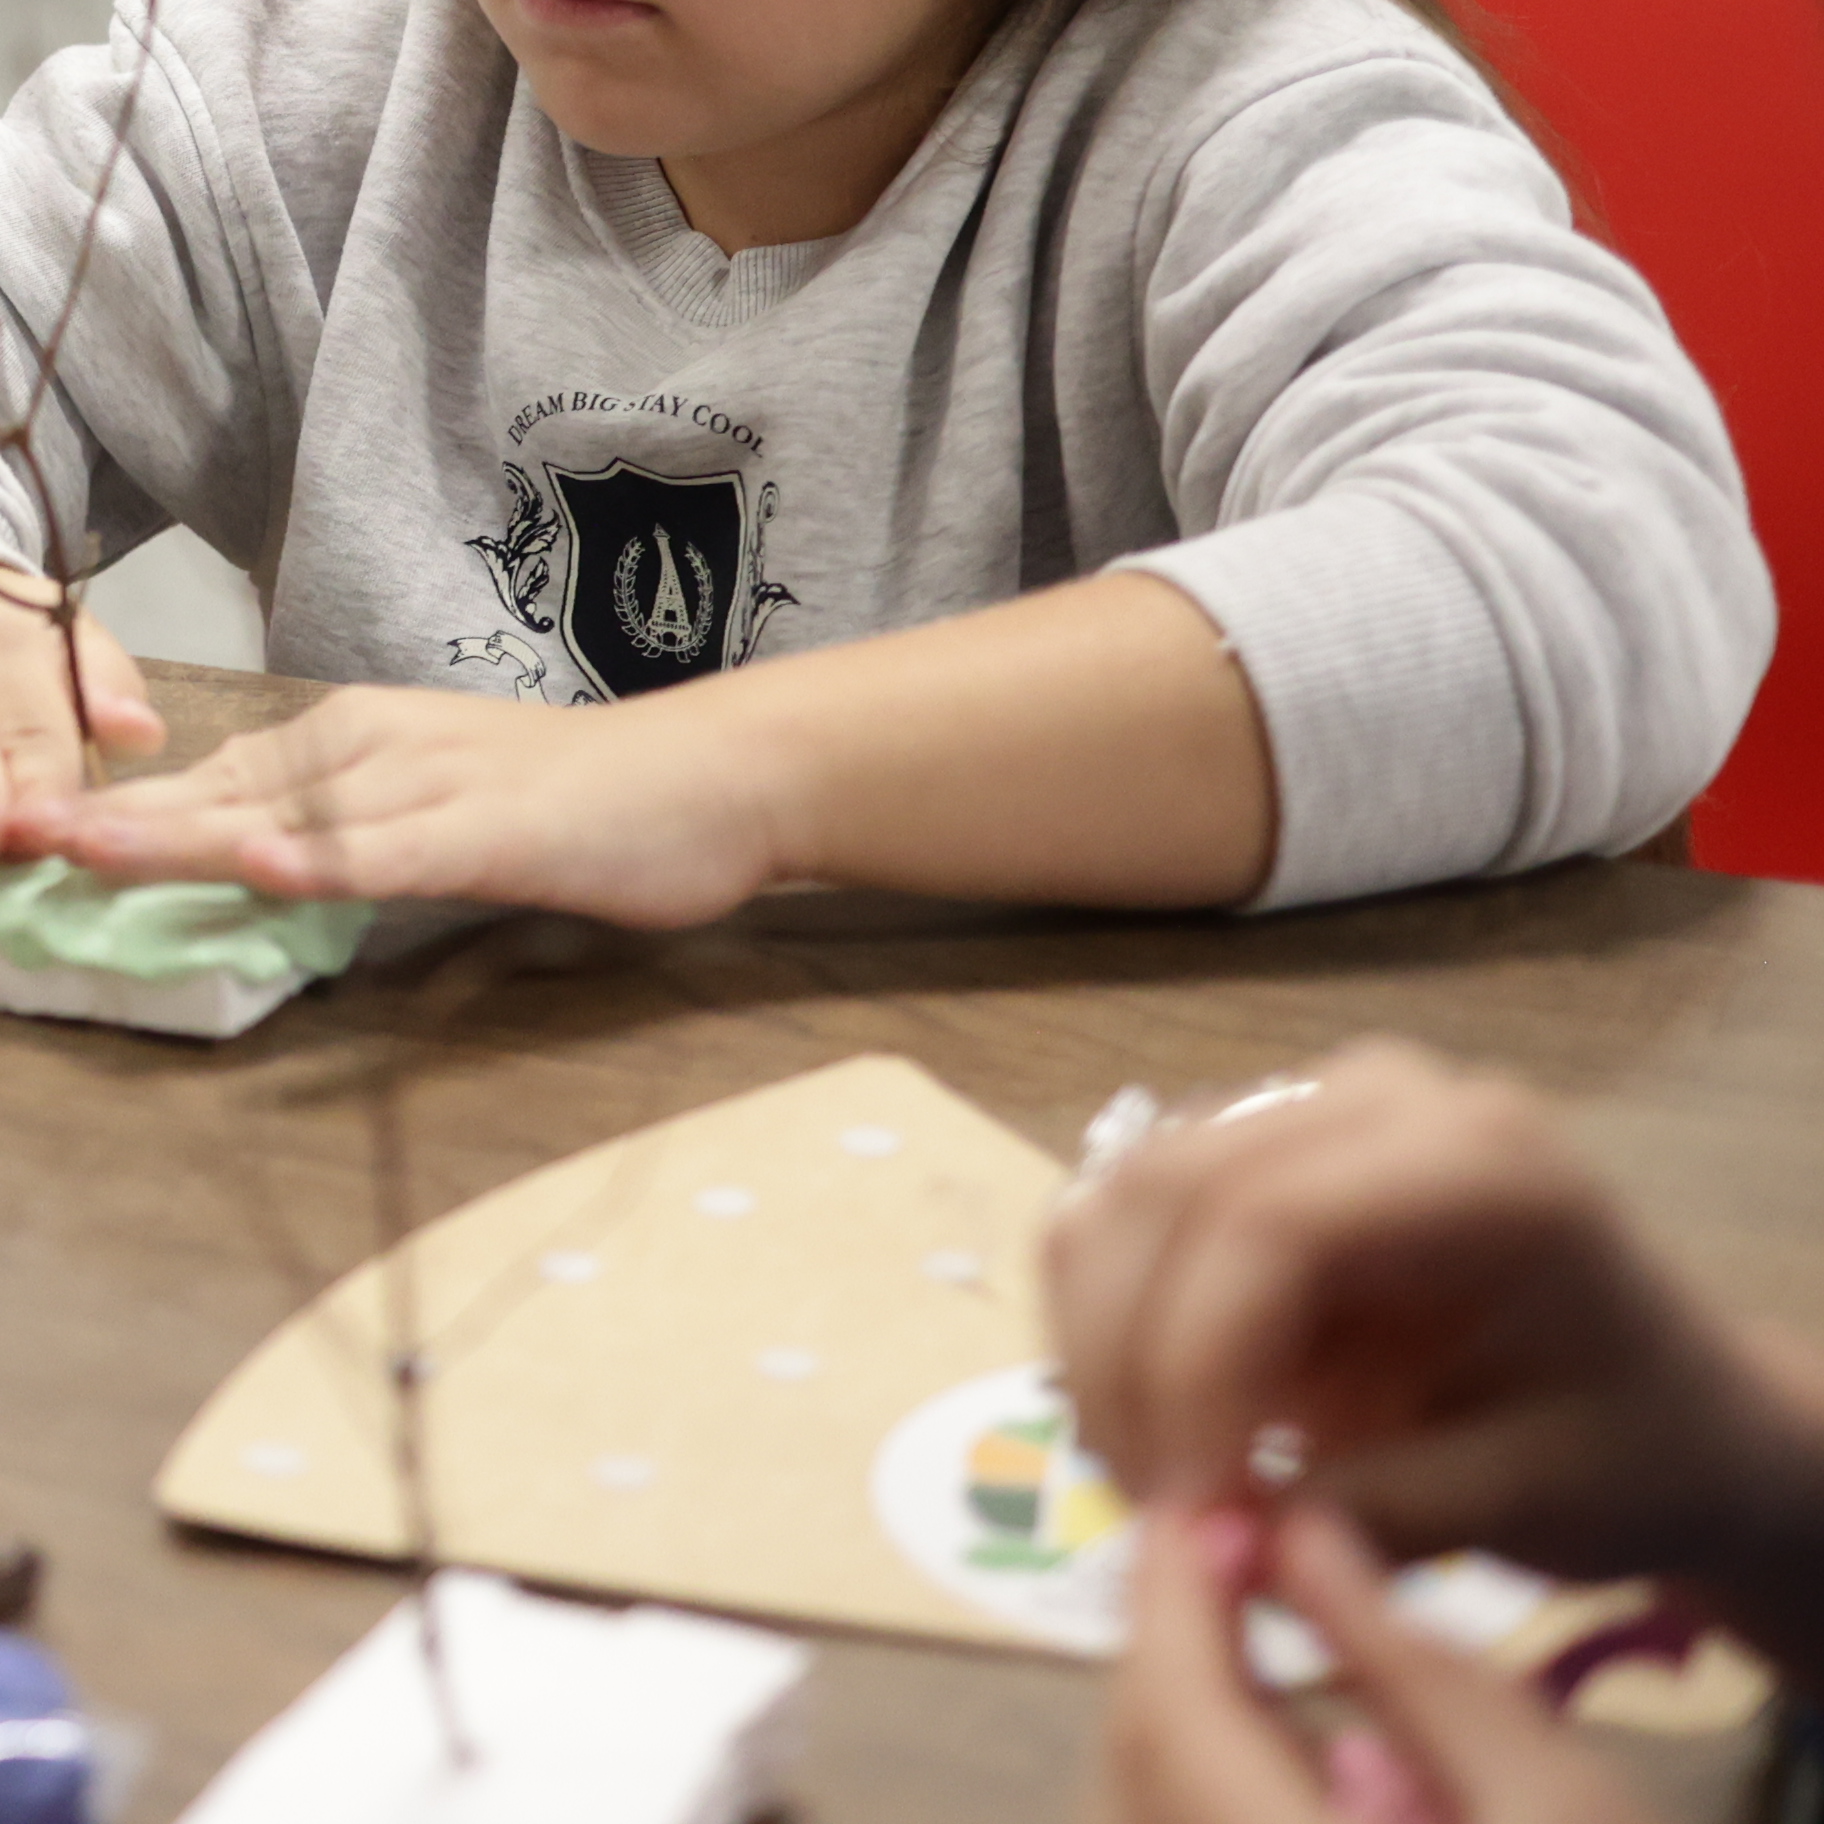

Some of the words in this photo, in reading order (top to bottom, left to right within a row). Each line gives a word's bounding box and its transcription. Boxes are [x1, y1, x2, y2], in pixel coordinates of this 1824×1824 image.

[507, 392, 565, 447] DREAM
[571, 391, 620, 412] BIG
[692, 404, 764, 458] COOL
